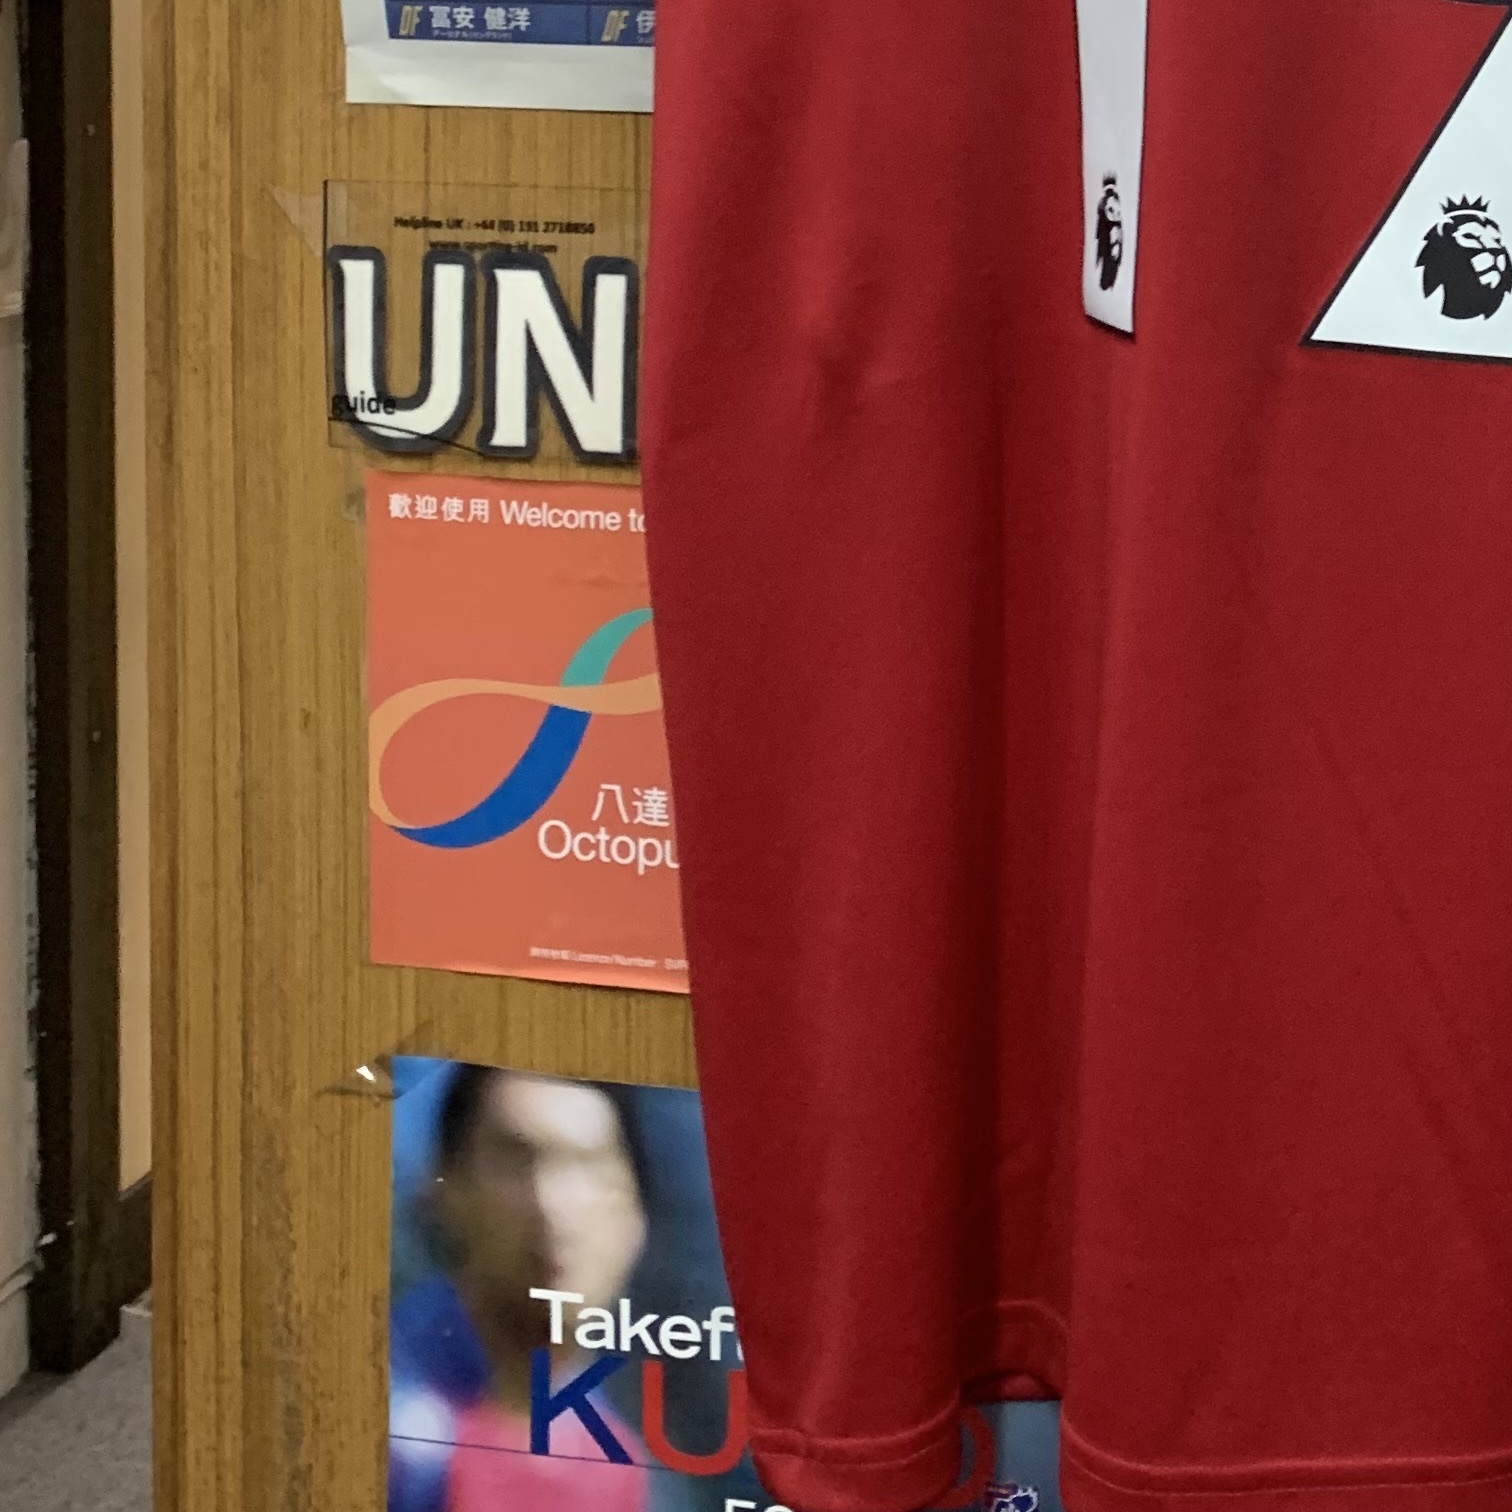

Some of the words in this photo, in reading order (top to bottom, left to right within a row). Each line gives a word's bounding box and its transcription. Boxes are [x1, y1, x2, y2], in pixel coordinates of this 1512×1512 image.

[388, 493, 490, 523] 歡迎使用
[500, 500, 622, 531] Welcome
[591, 783, 670, 827] 八達
